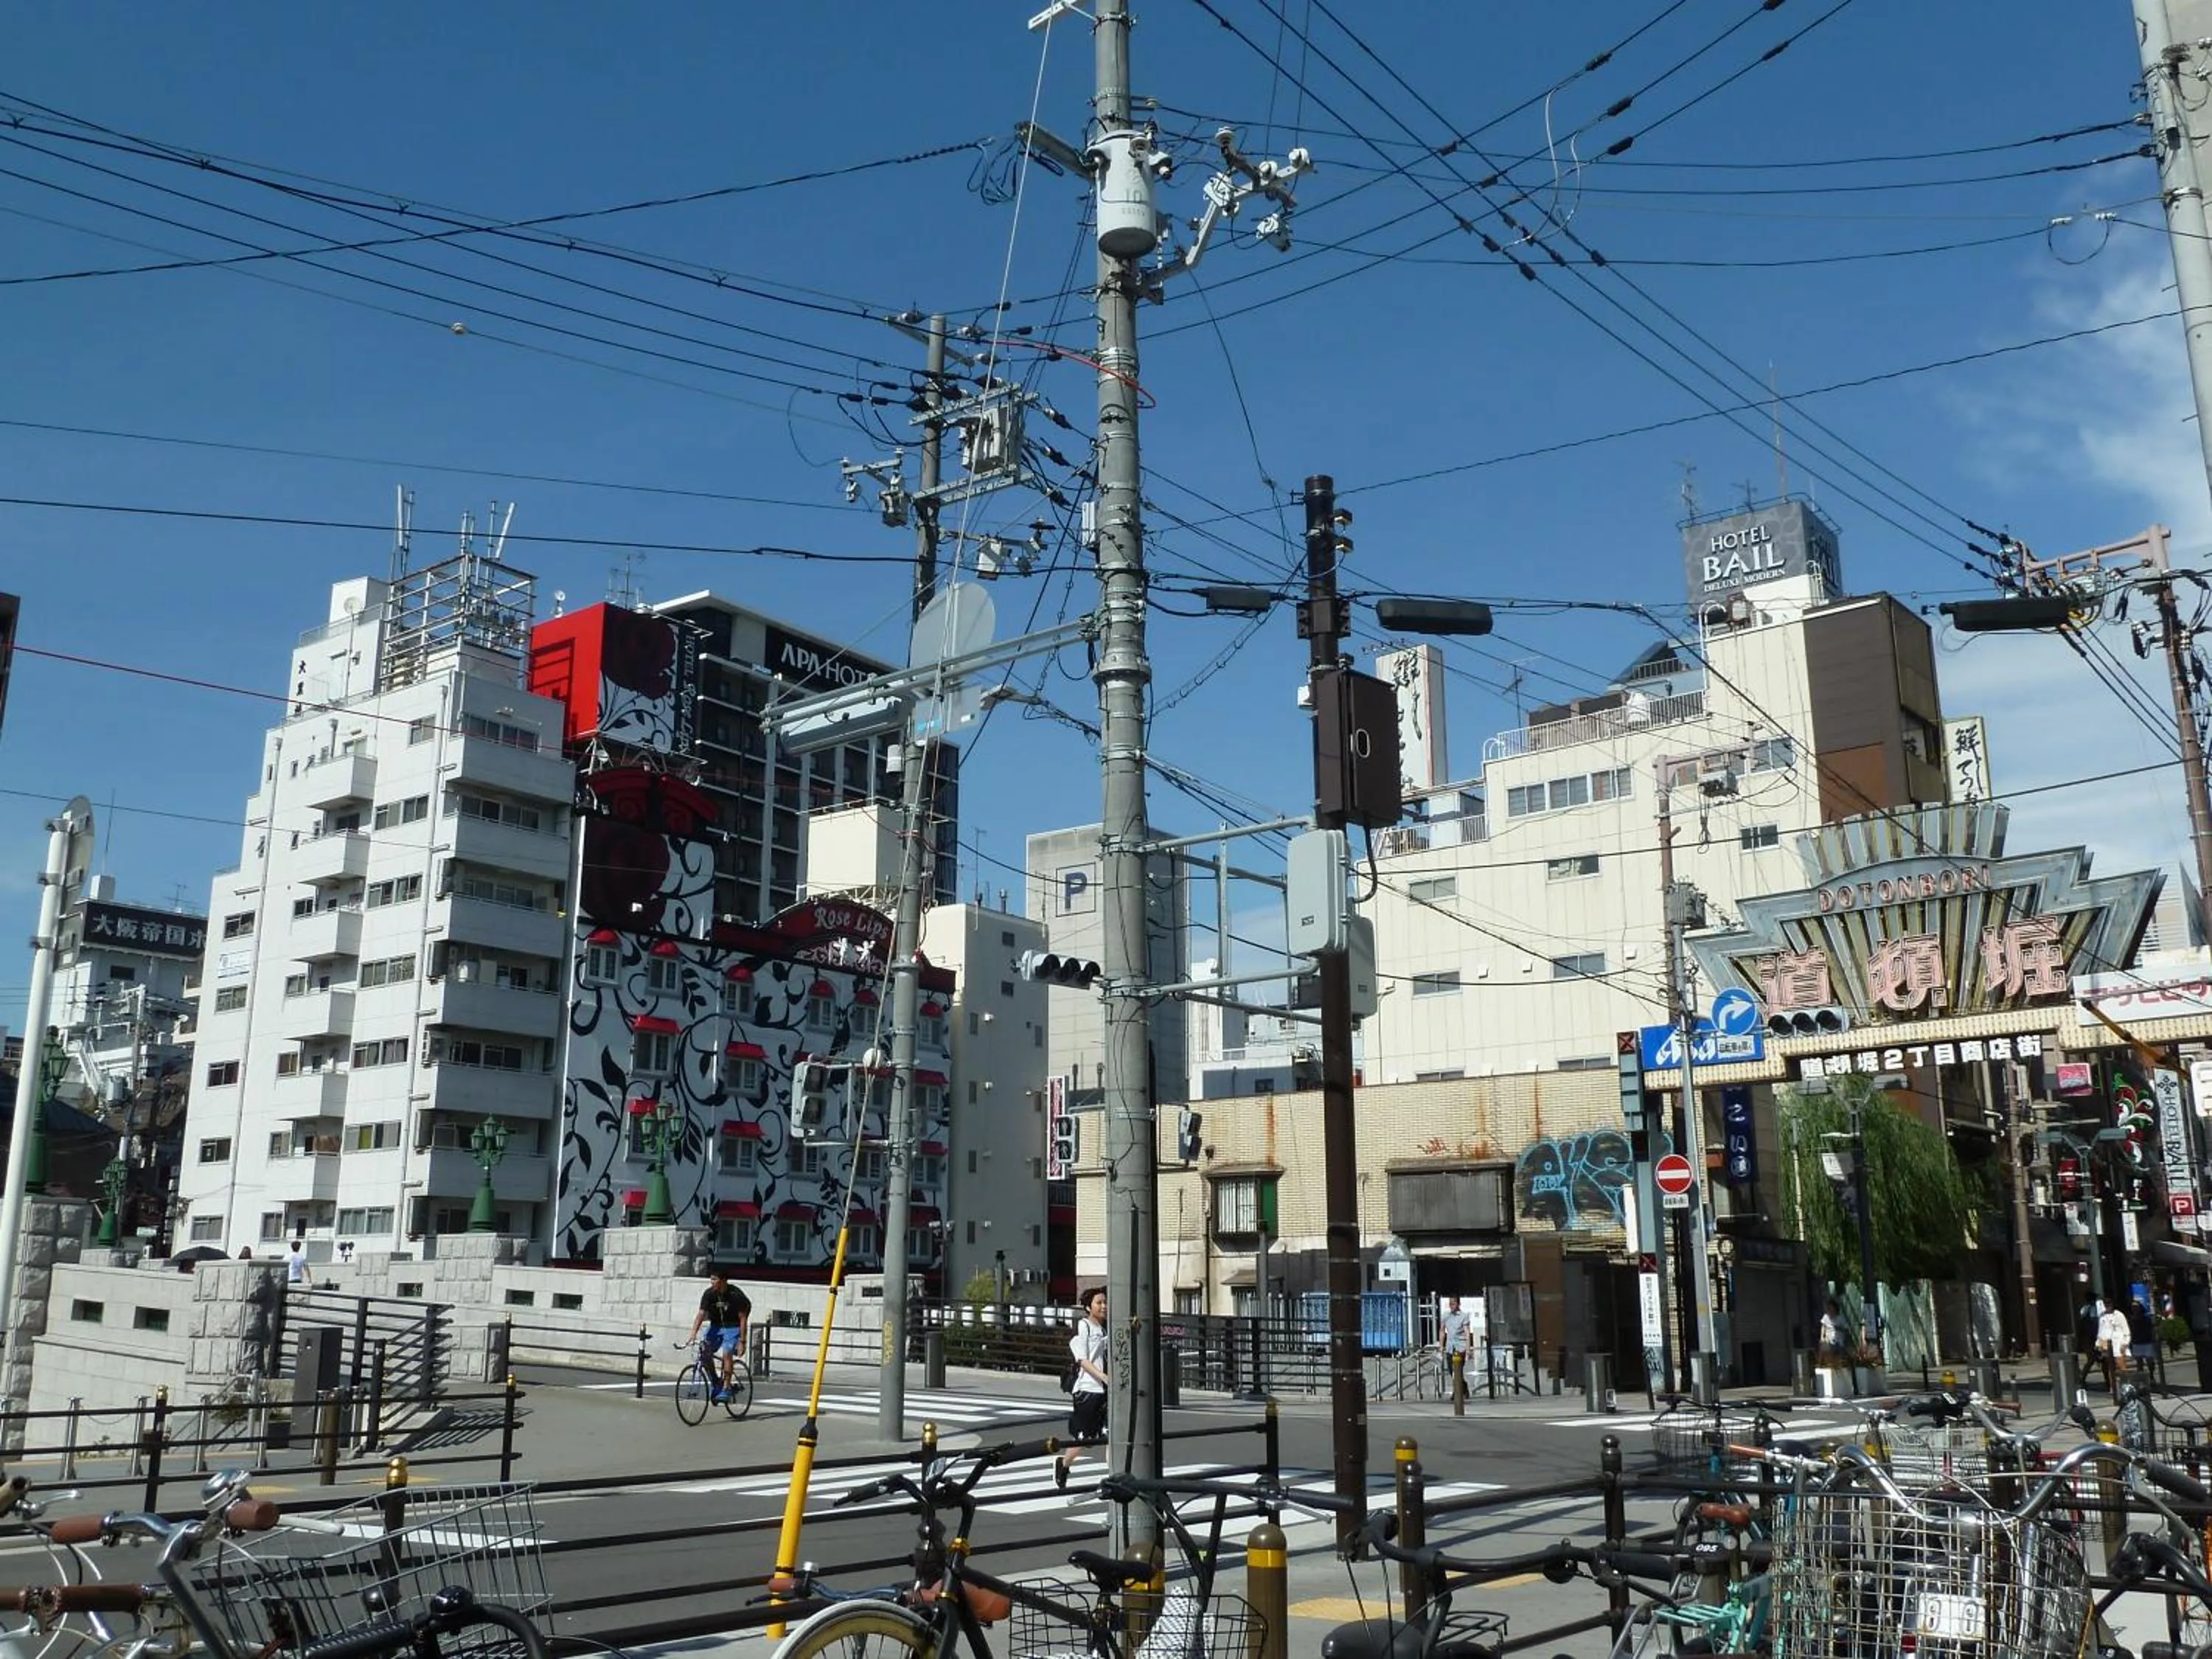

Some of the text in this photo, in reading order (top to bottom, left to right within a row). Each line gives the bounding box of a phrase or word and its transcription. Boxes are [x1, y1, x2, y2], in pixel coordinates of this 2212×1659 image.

[1711, 525, 1771, 552] HOTEL
[1703, 543, 1786, 582] BAIL
[1704, 568, 1786, 593] DELUXE MODERN
[781, 642, 873, 686] APA HOT
[1065, 872, 1087, 909] P
[1818, 864, 1991, 913] DOTONBORI
[814, 906, 888, 939] Rose Lips
[1756, 916, 2067, 1016] 道頓堀
[1800, 1035, 2042, 1078] 道頓堀2丁目商店街
[2165, 1096, 2191, 1189] HOTEL BAIL
[2175, 1200, 2189, 1213] P
